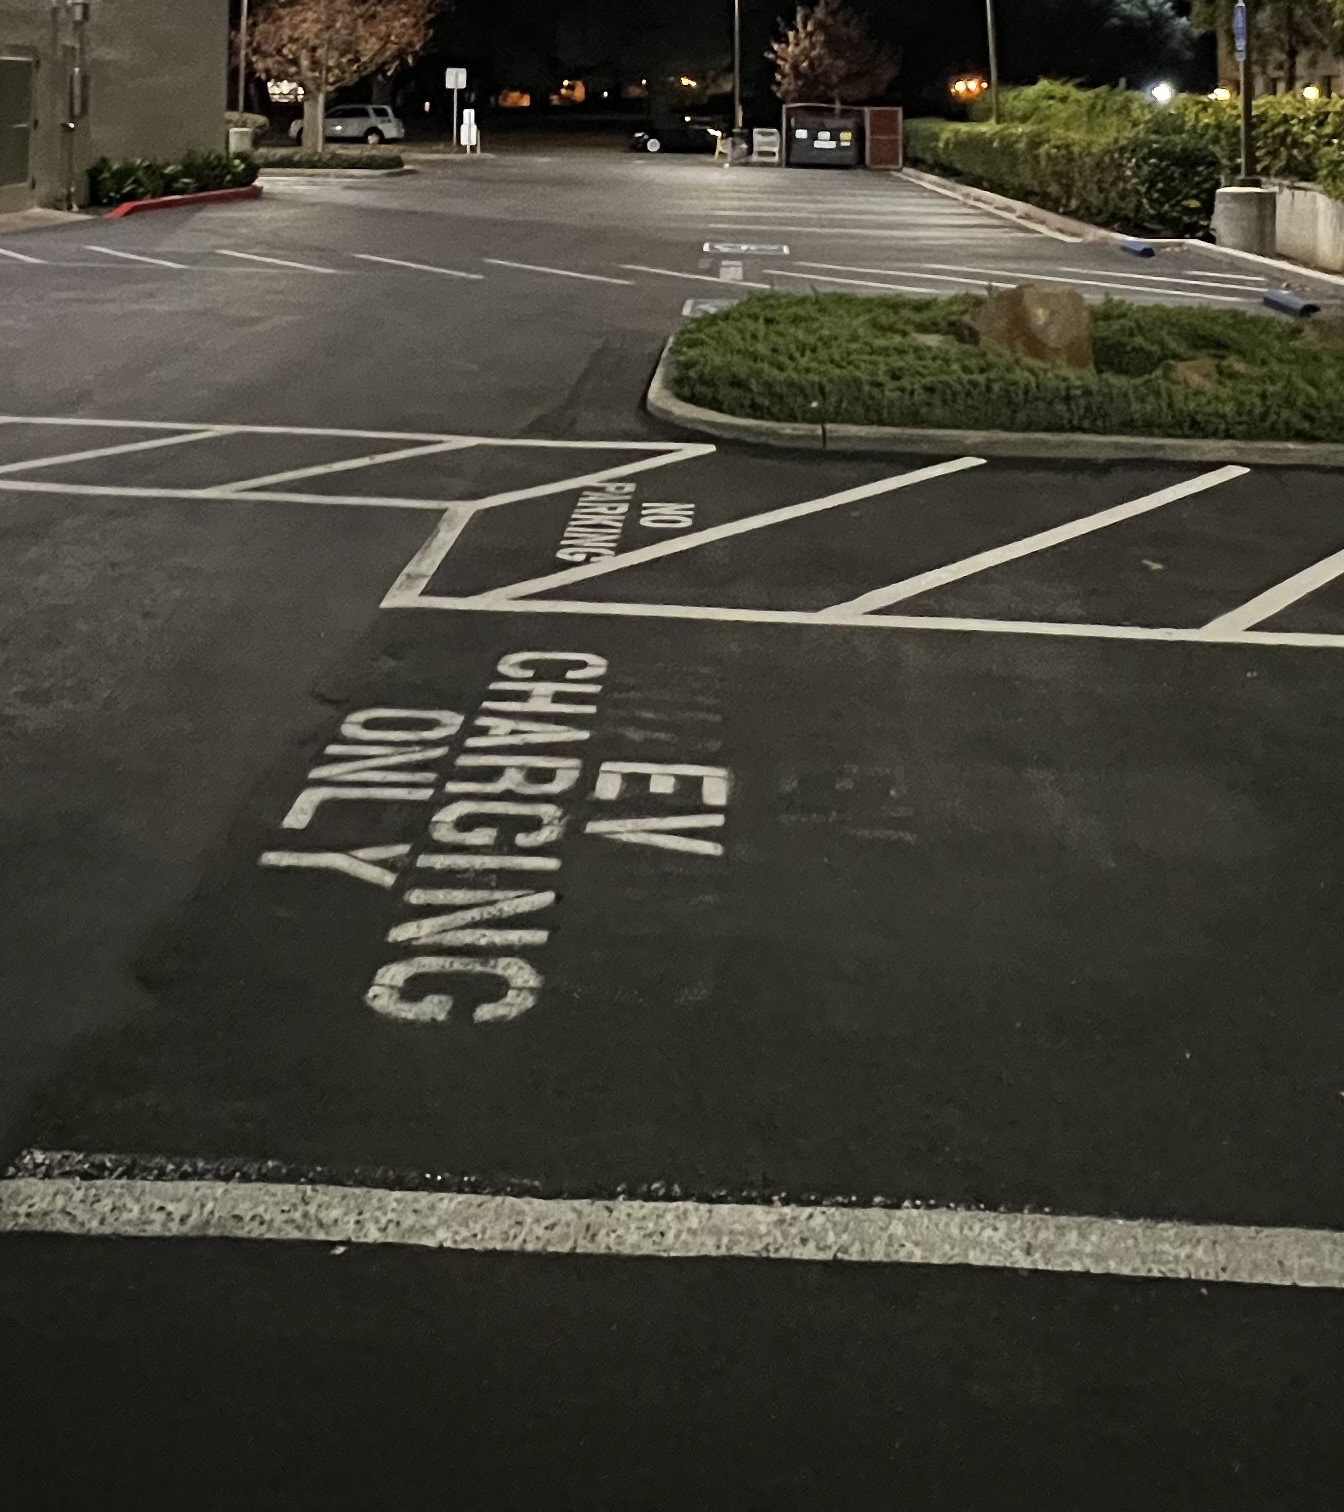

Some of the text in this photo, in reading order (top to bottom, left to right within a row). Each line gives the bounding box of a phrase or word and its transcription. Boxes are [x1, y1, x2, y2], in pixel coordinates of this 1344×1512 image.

[556, 482, 636, 562] PARKING
[639, 502, 695, 528] NO
[257, 708, 464, 887] ONLY
[365, 651, 609, 1023] CHARGING
[584, 761, 730, 856] EV
